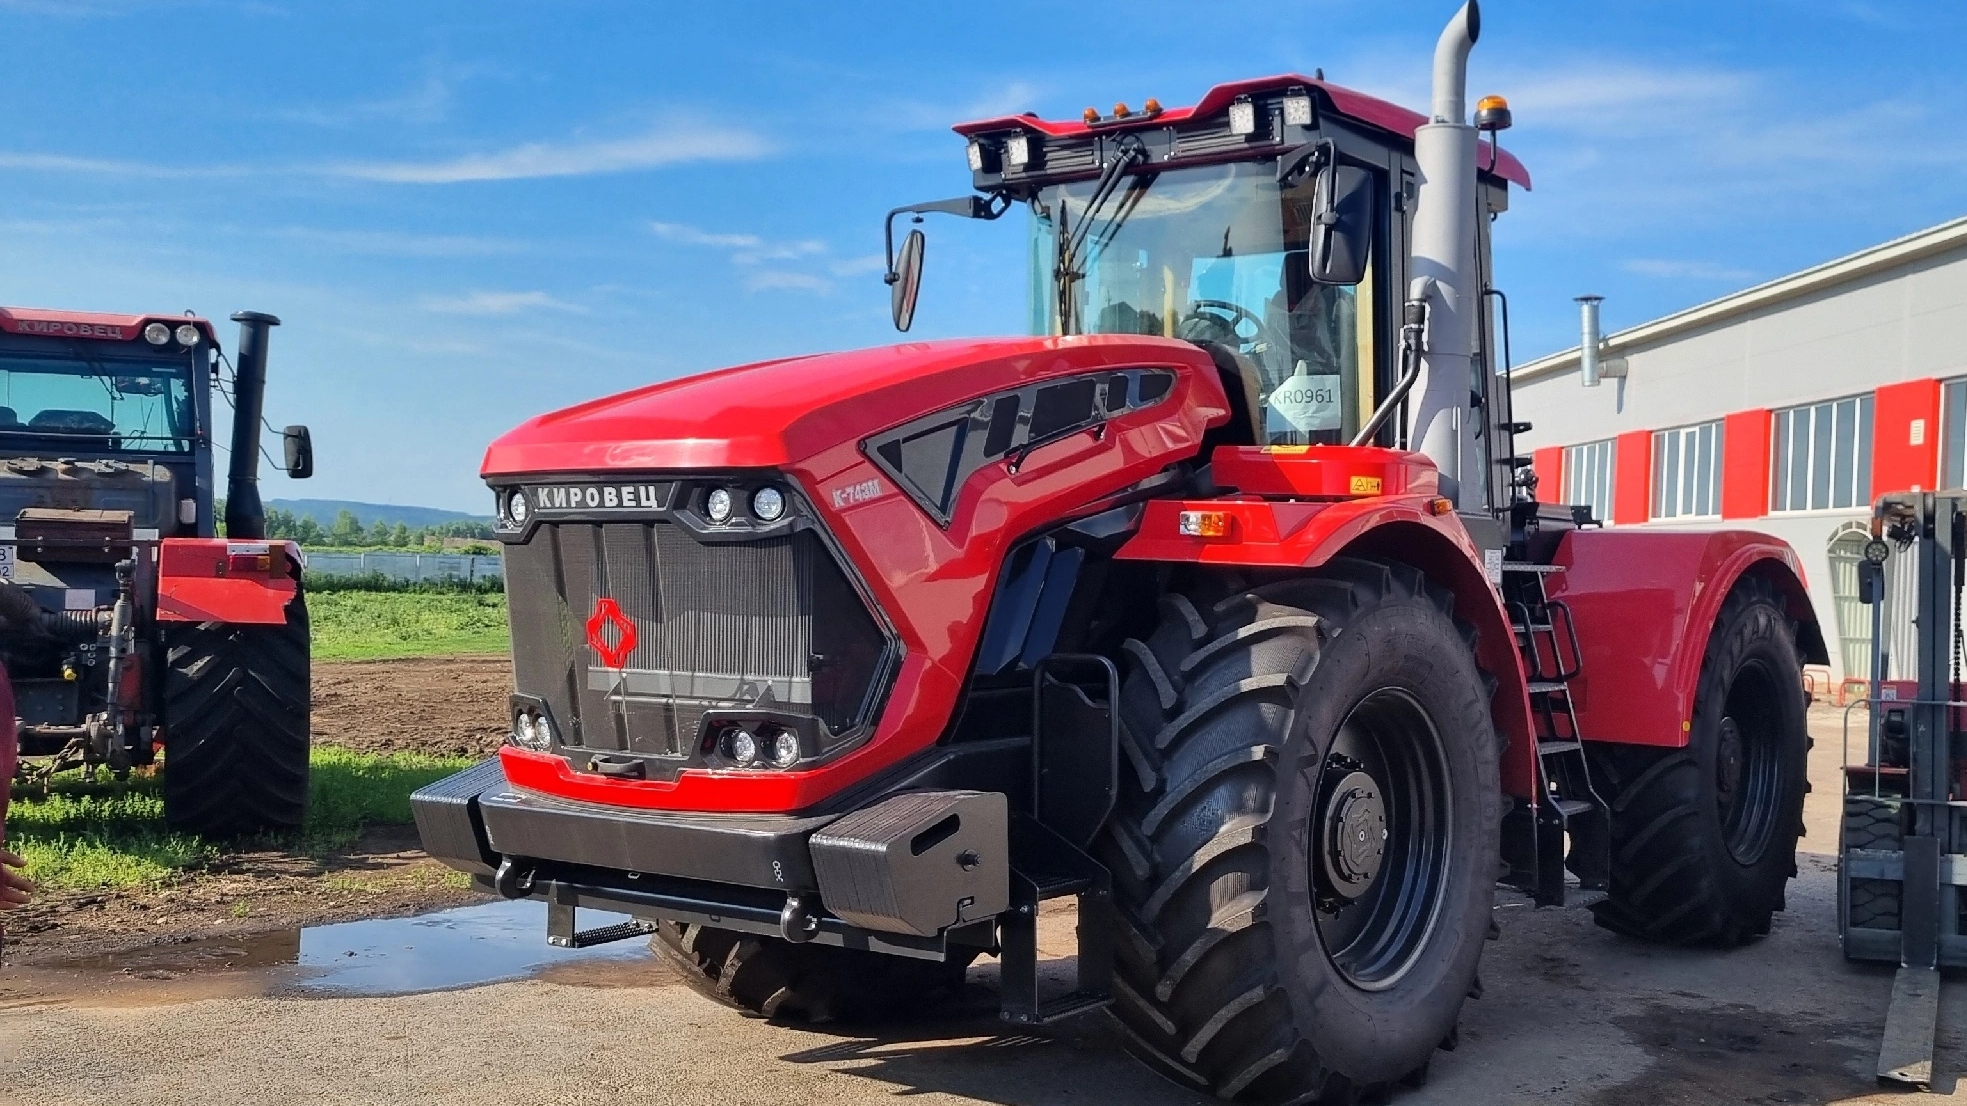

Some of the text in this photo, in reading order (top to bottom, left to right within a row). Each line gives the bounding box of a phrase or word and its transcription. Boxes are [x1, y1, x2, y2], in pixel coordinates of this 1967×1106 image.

[18, 320, 123, 339] КИРОВЕЦ
[1273, 388, 1335, 405] KR0961
[538, 485, 658, 508] КИРОВЕЦ
